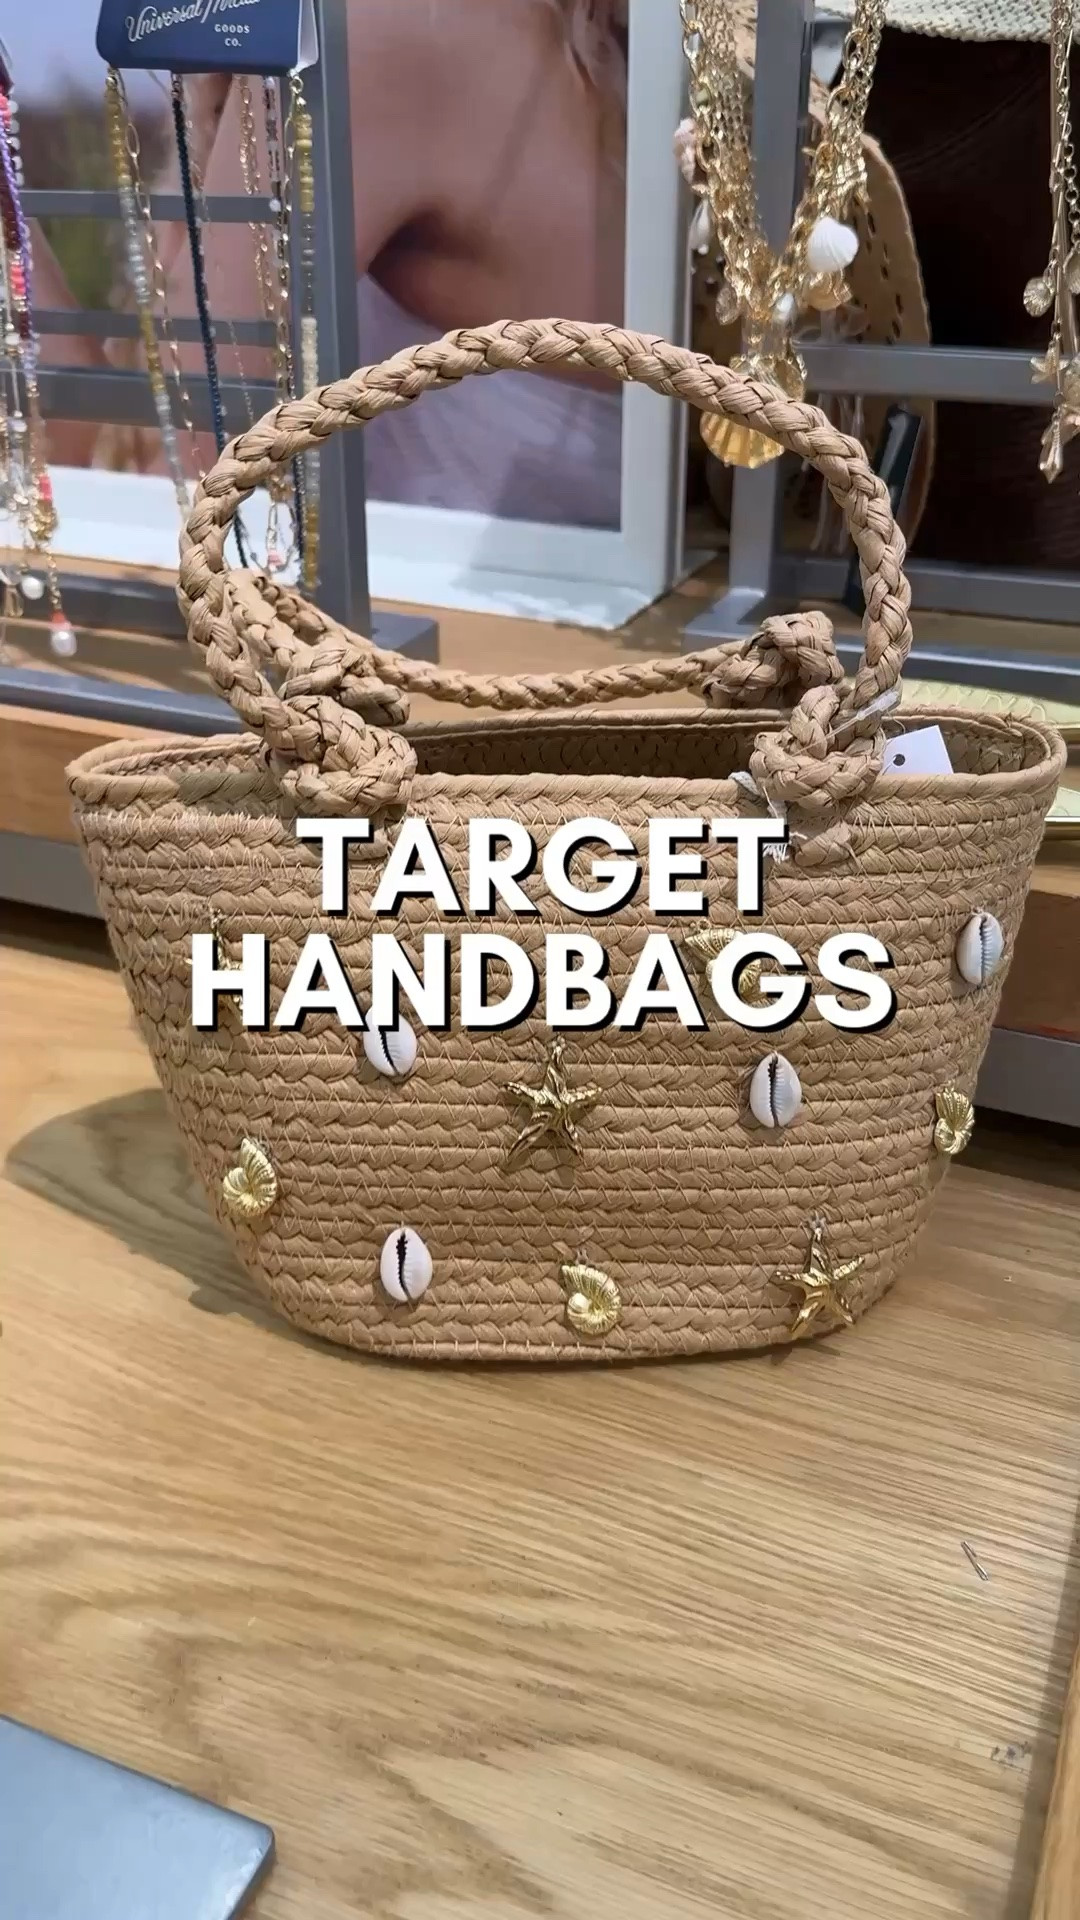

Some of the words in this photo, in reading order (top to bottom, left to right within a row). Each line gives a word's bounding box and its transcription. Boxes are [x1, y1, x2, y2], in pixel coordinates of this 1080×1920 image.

[124, 0, 203, 42] Universal
[214, 23, 250, 33] GOODS
[224, 37, 242, 47] CO.
